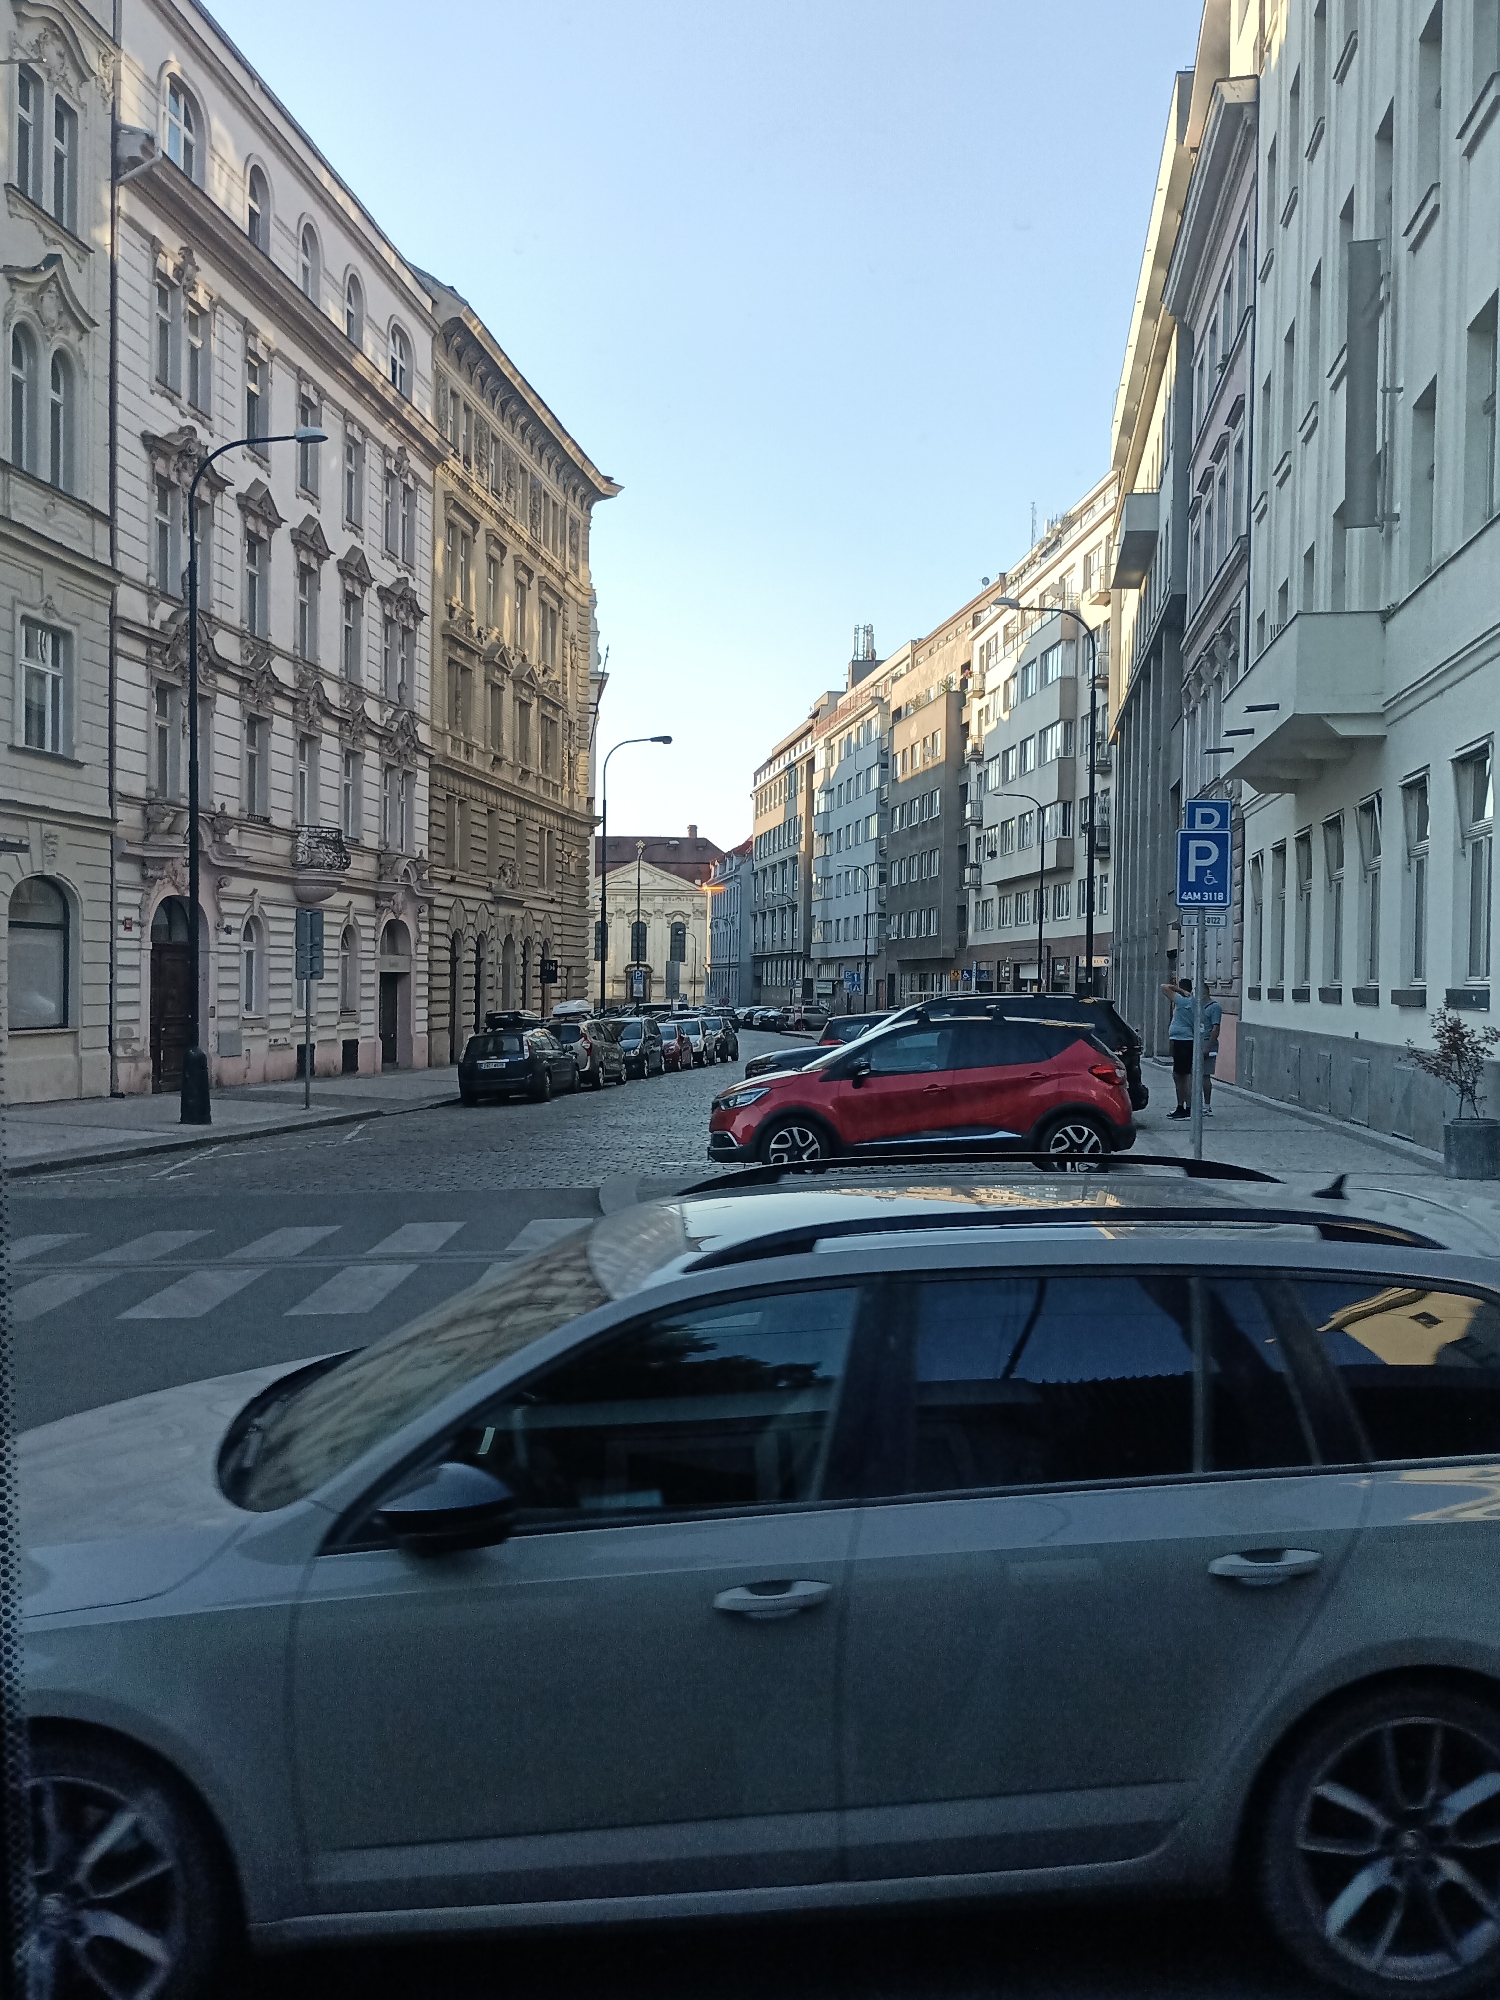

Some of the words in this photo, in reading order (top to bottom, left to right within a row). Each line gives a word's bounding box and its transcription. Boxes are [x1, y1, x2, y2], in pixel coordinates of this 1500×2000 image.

[1195, 807, 1221, 830] P
[1187, 839, 1219, 882] P
[1181, 891, 1200, 901] 4AM
[1202, 892, 1224, 901] 3118
[635, 970, 642, 980] P
